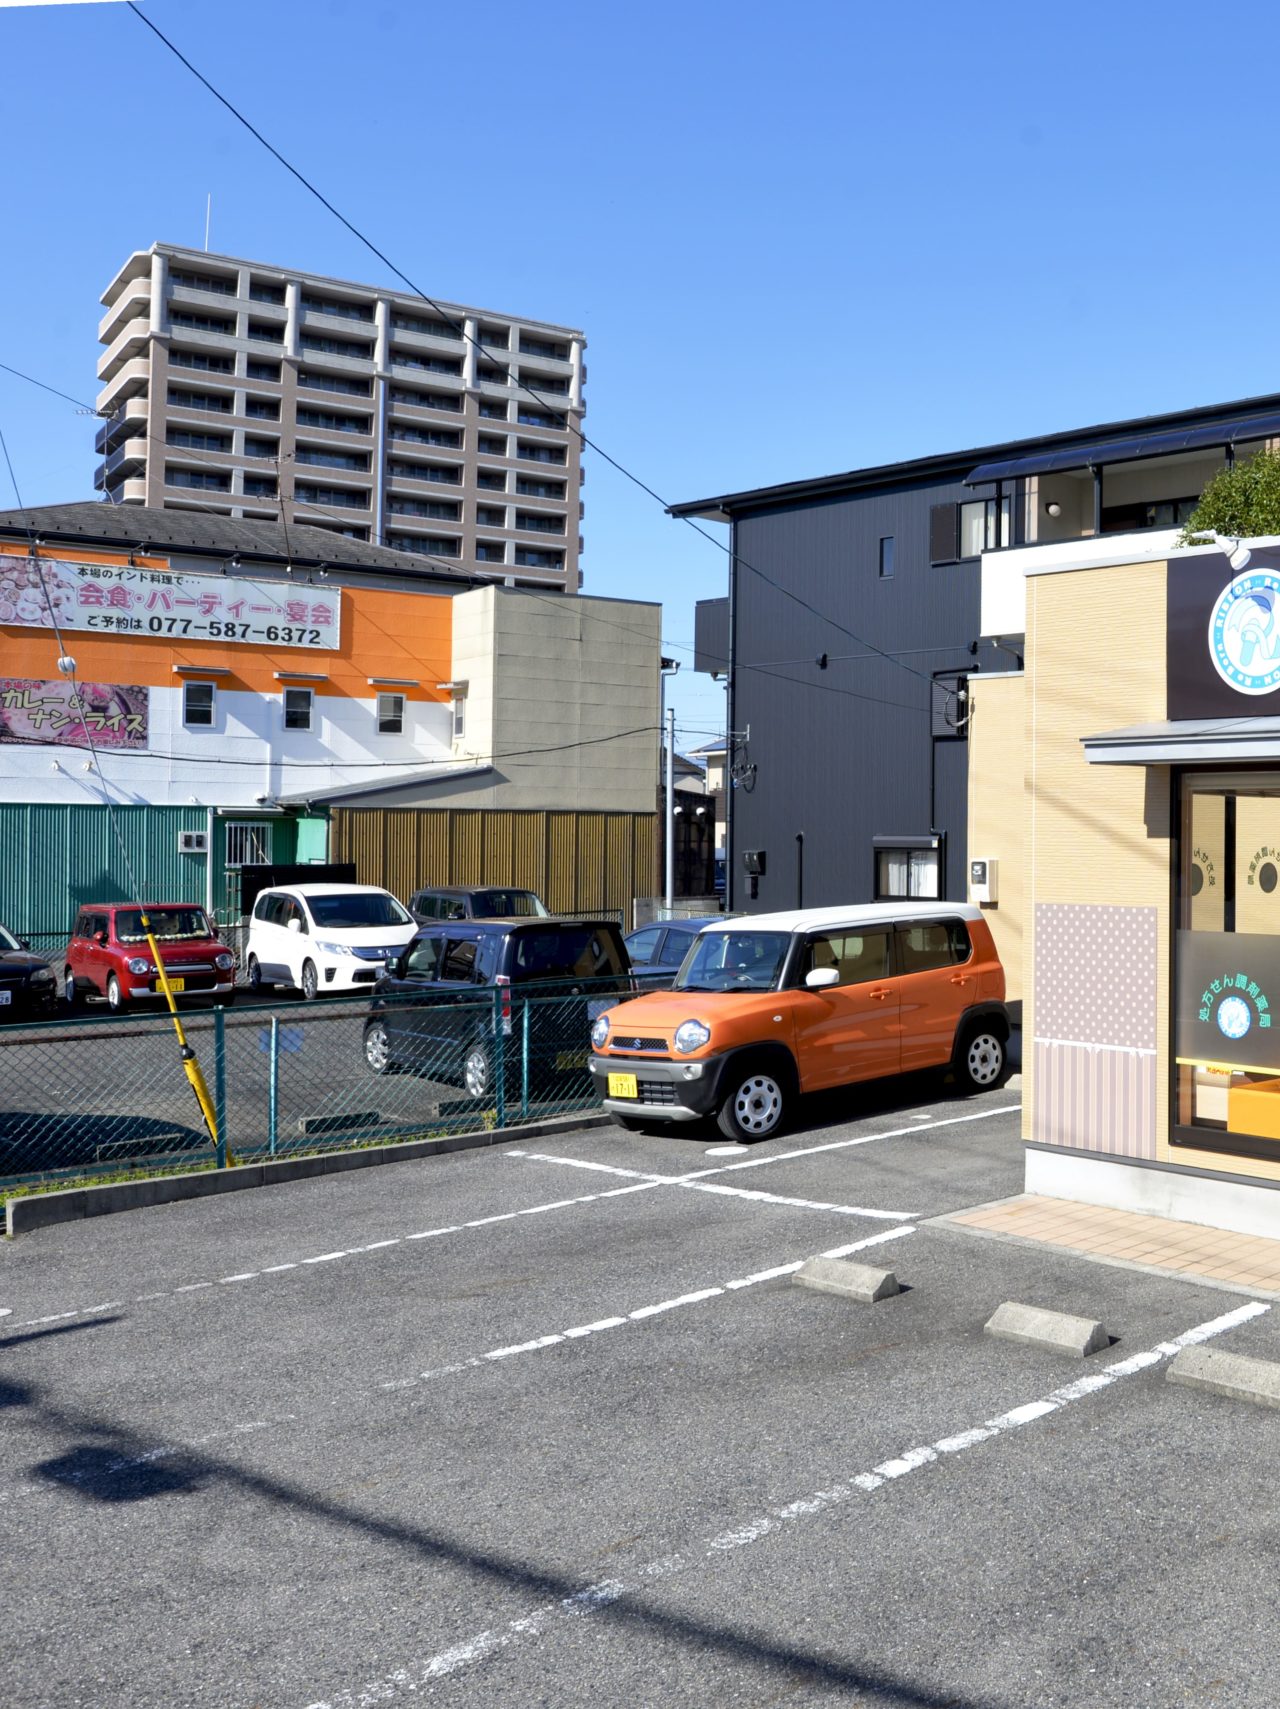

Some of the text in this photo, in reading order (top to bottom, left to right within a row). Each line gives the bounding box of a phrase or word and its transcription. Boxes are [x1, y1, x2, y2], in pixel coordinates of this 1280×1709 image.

[87, 615, 321, 644] ご予約は 077-587-6372
[2, 688, 65, 709] カレー
[28, 709, 145, 732] ナン・ライス
[1198, 973, 1271, 1028] 処方せん調剤薬局
